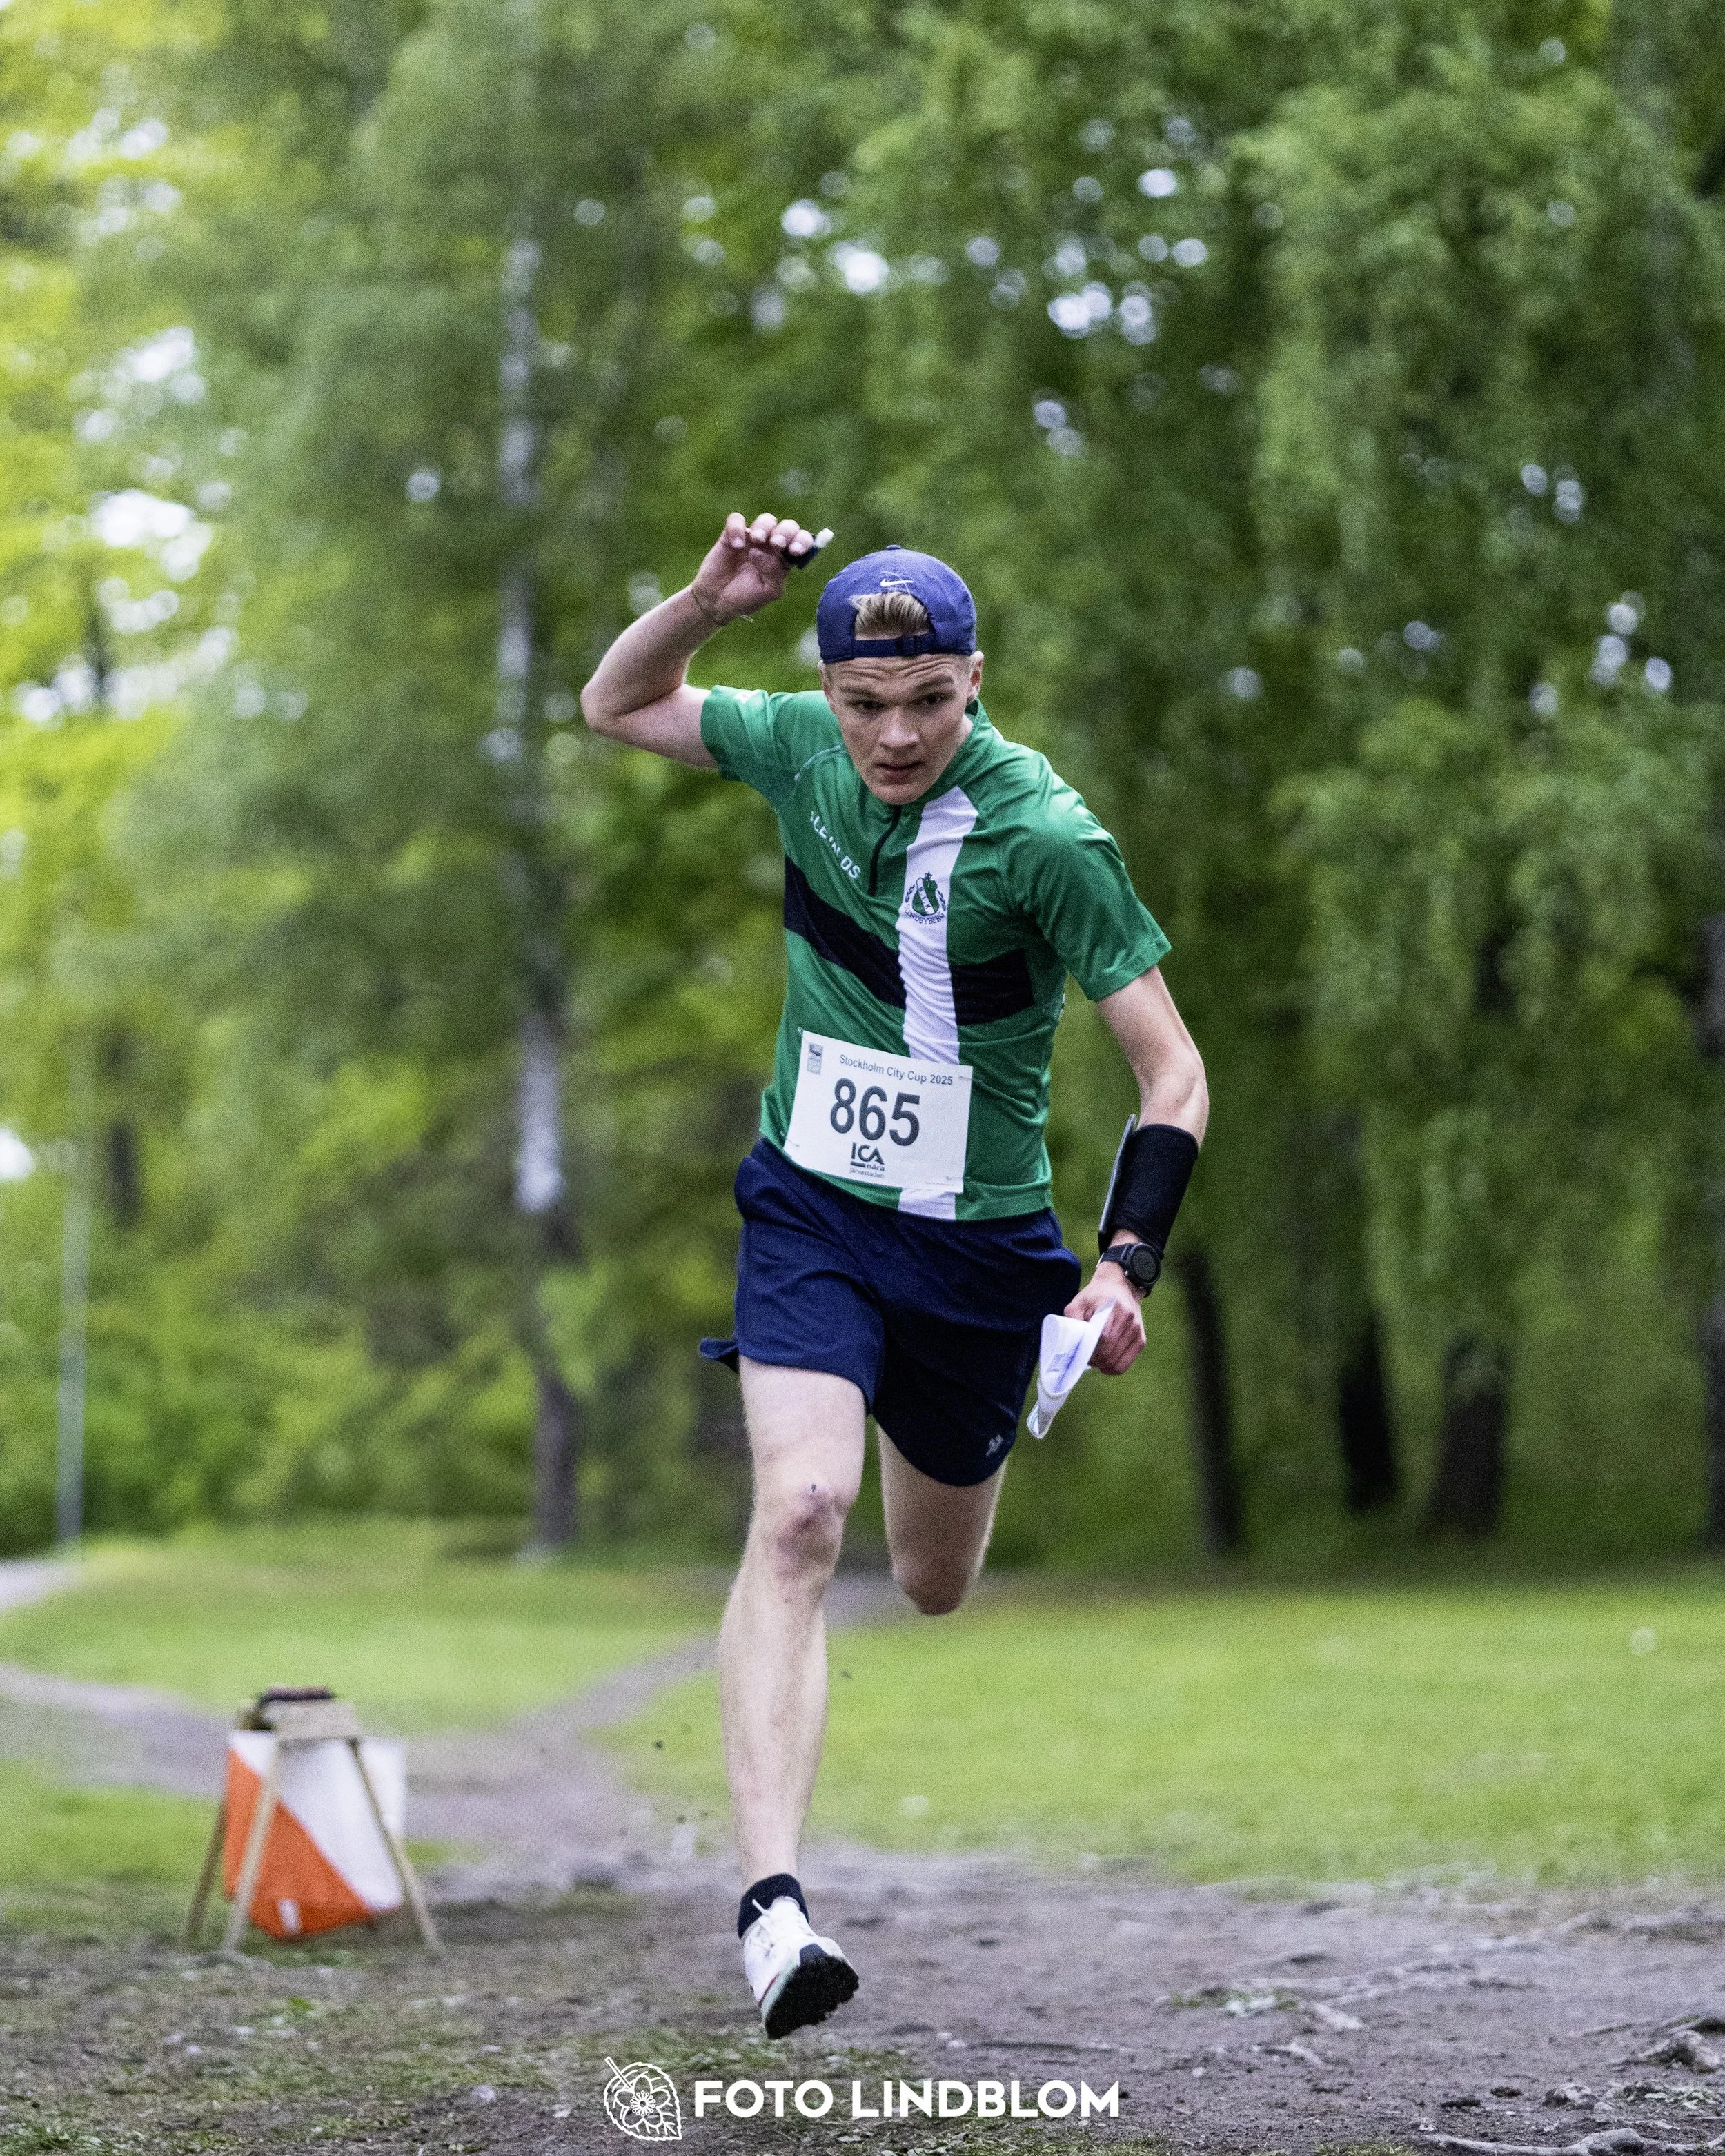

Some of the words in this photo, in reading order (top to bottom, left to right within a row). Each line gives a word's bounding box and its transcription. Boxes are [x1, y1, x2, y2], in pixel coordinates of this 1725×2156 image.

[840, 1054, 884, 1074] Stockholm
[887, 1066, 905, 1080] City
[907, 1071, 927, 1084] Cup
[929, 1074, 953, 1085] 2025
[830, 1078, 920, 1147] 865
[851, 1142, 885, 1165] ICA
